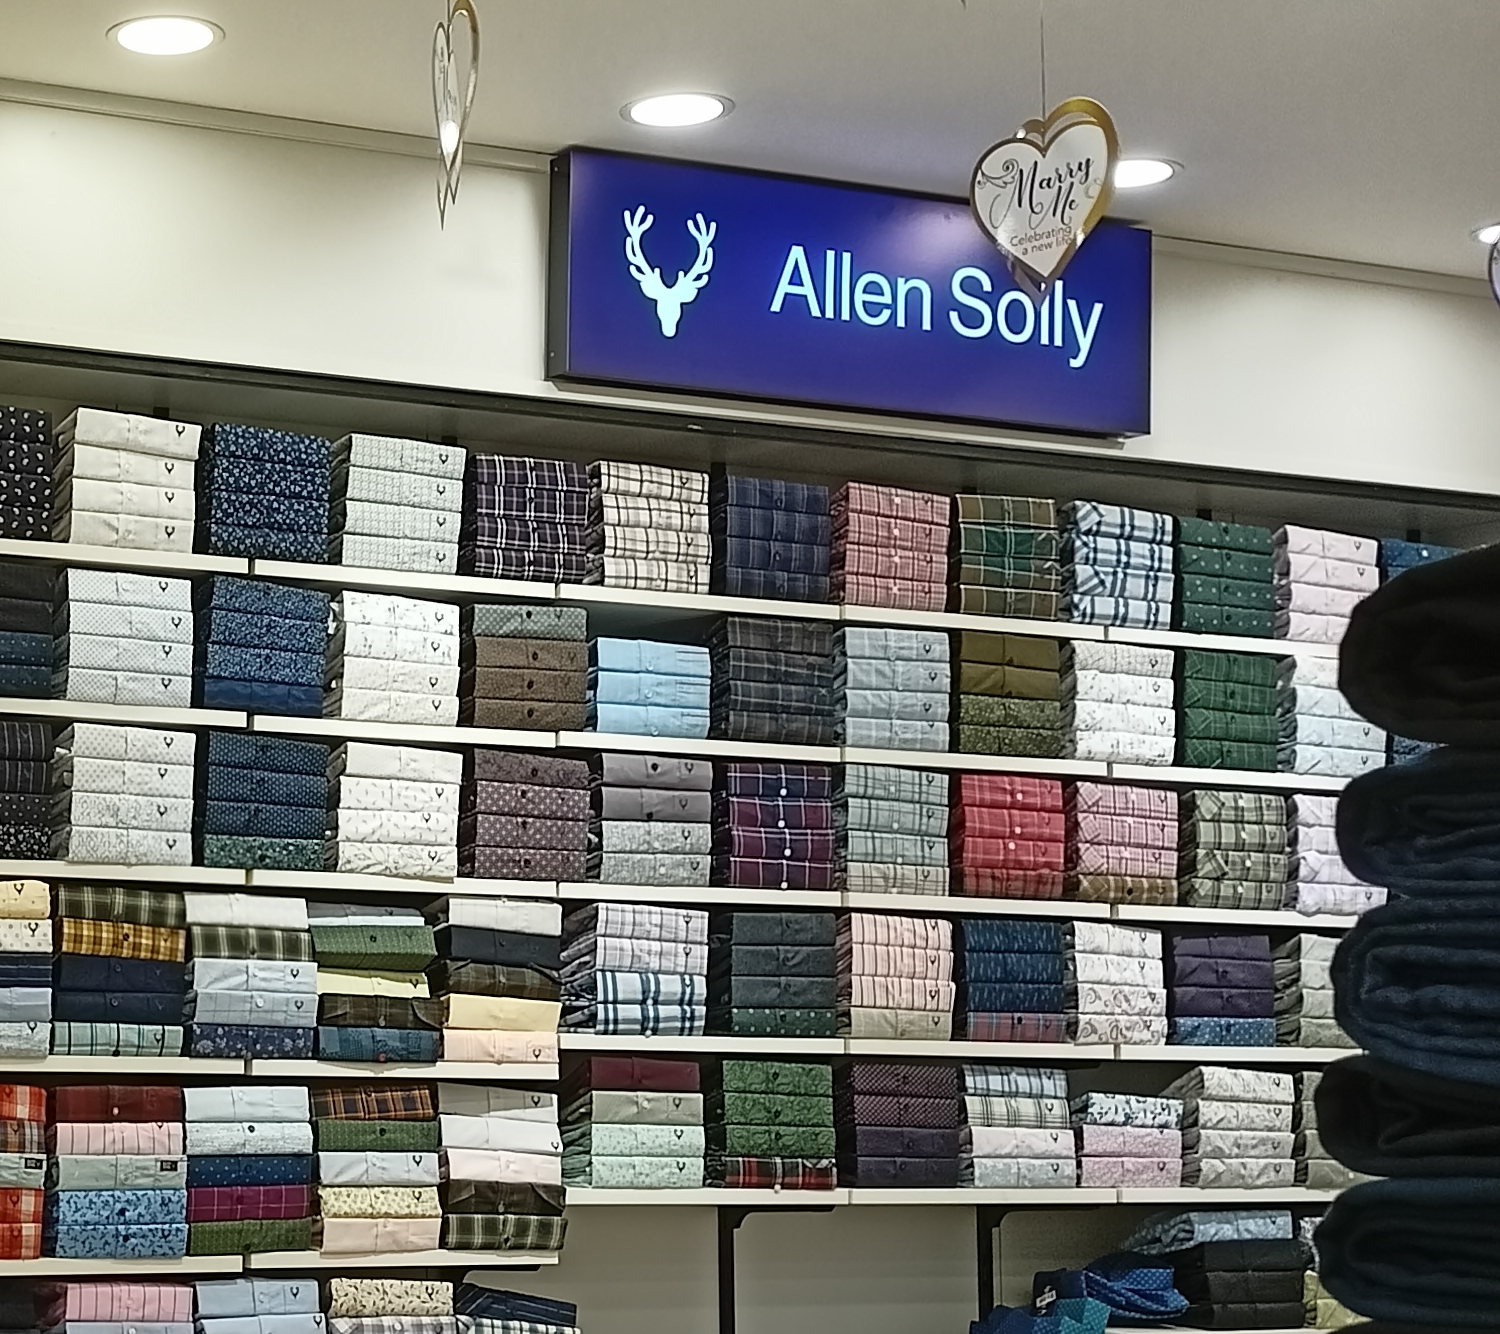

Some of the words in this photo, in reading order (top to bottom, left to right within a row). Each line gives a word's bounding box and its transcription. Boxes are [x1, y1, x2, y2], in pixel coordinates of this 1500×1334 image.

[989, 158, 1094, 229] Marry
[1028, 182, 1079, 230] Me
[1010, 225, 1072, 247] Celebrating
[1031, 241, 1051, 253] new
[770, 245, 933, 331] Allen
[949, 267, 1103, 369] Solly
